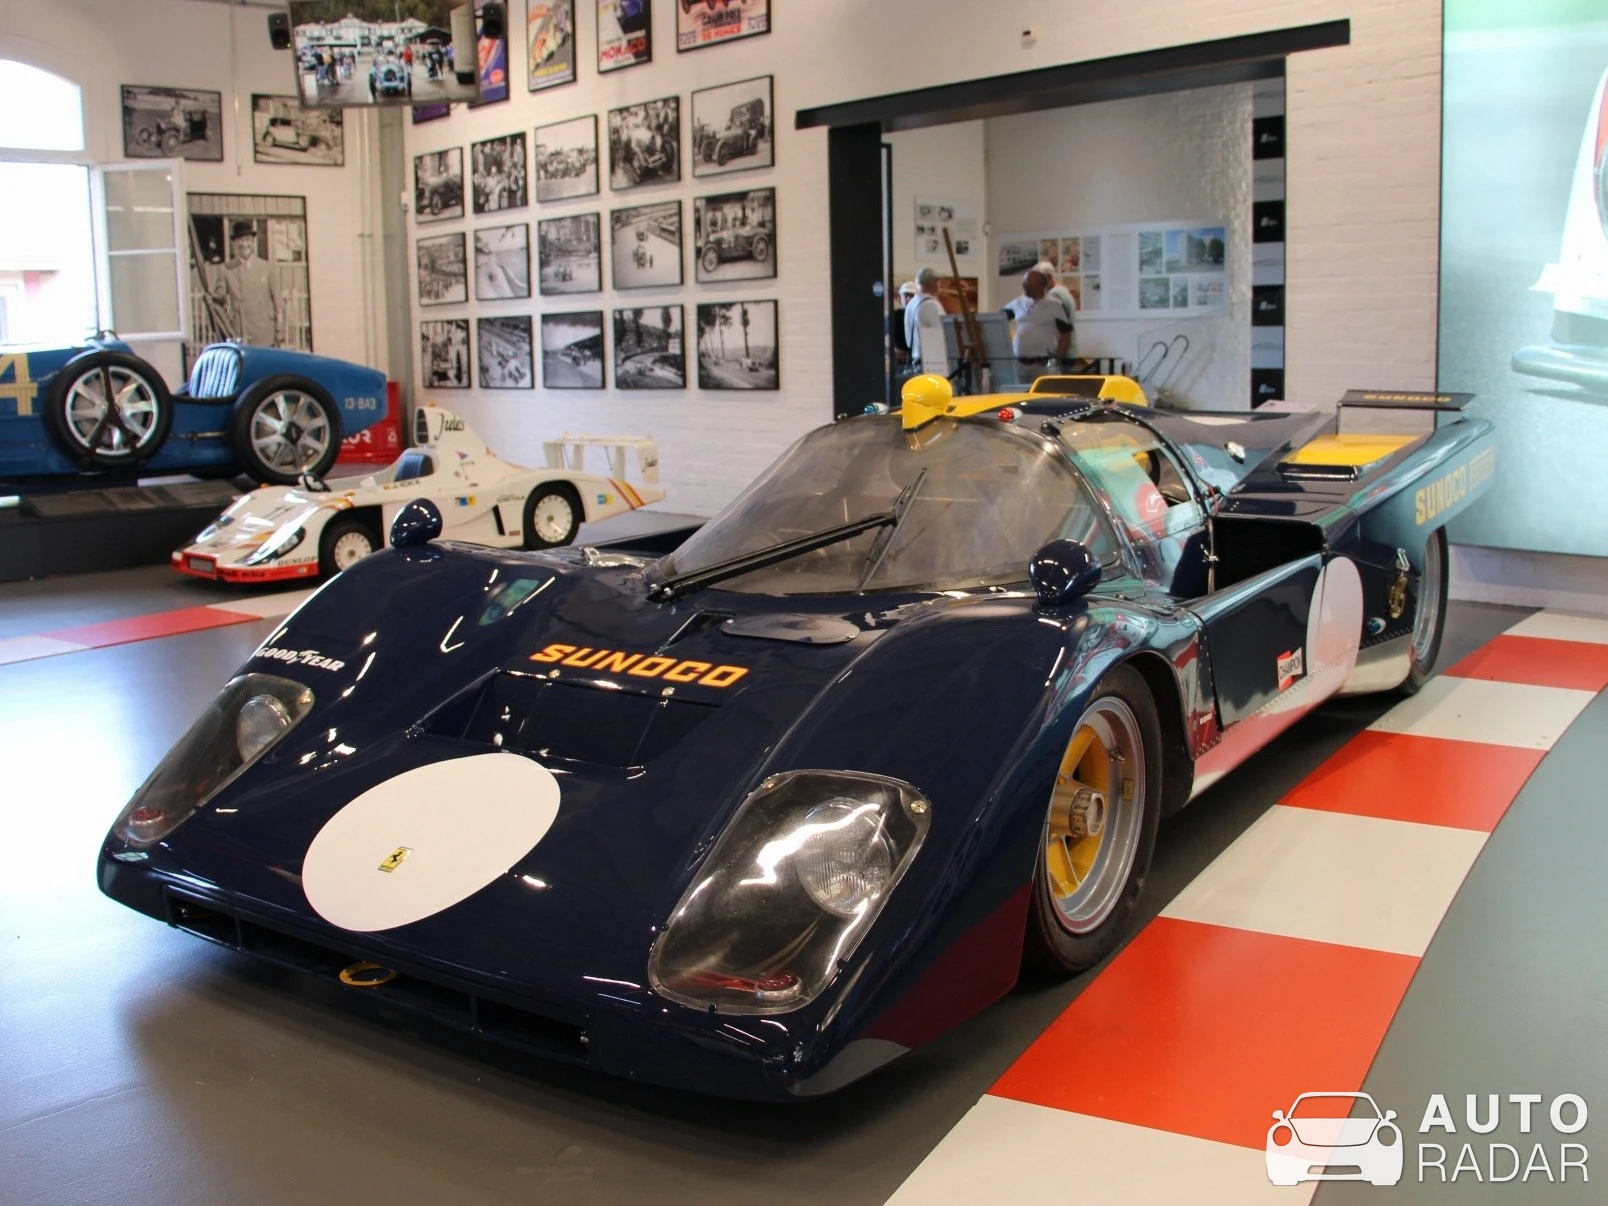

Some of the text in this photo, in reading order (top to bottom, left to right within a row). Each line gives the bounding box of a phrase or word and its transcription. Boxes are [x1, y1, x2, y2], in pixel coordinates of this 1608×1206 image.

[434, 413, 465, 441] Jules
[1415, 465, 1467, 526] SUNOCO
[529, 643, 749, 688] SUNOCO
